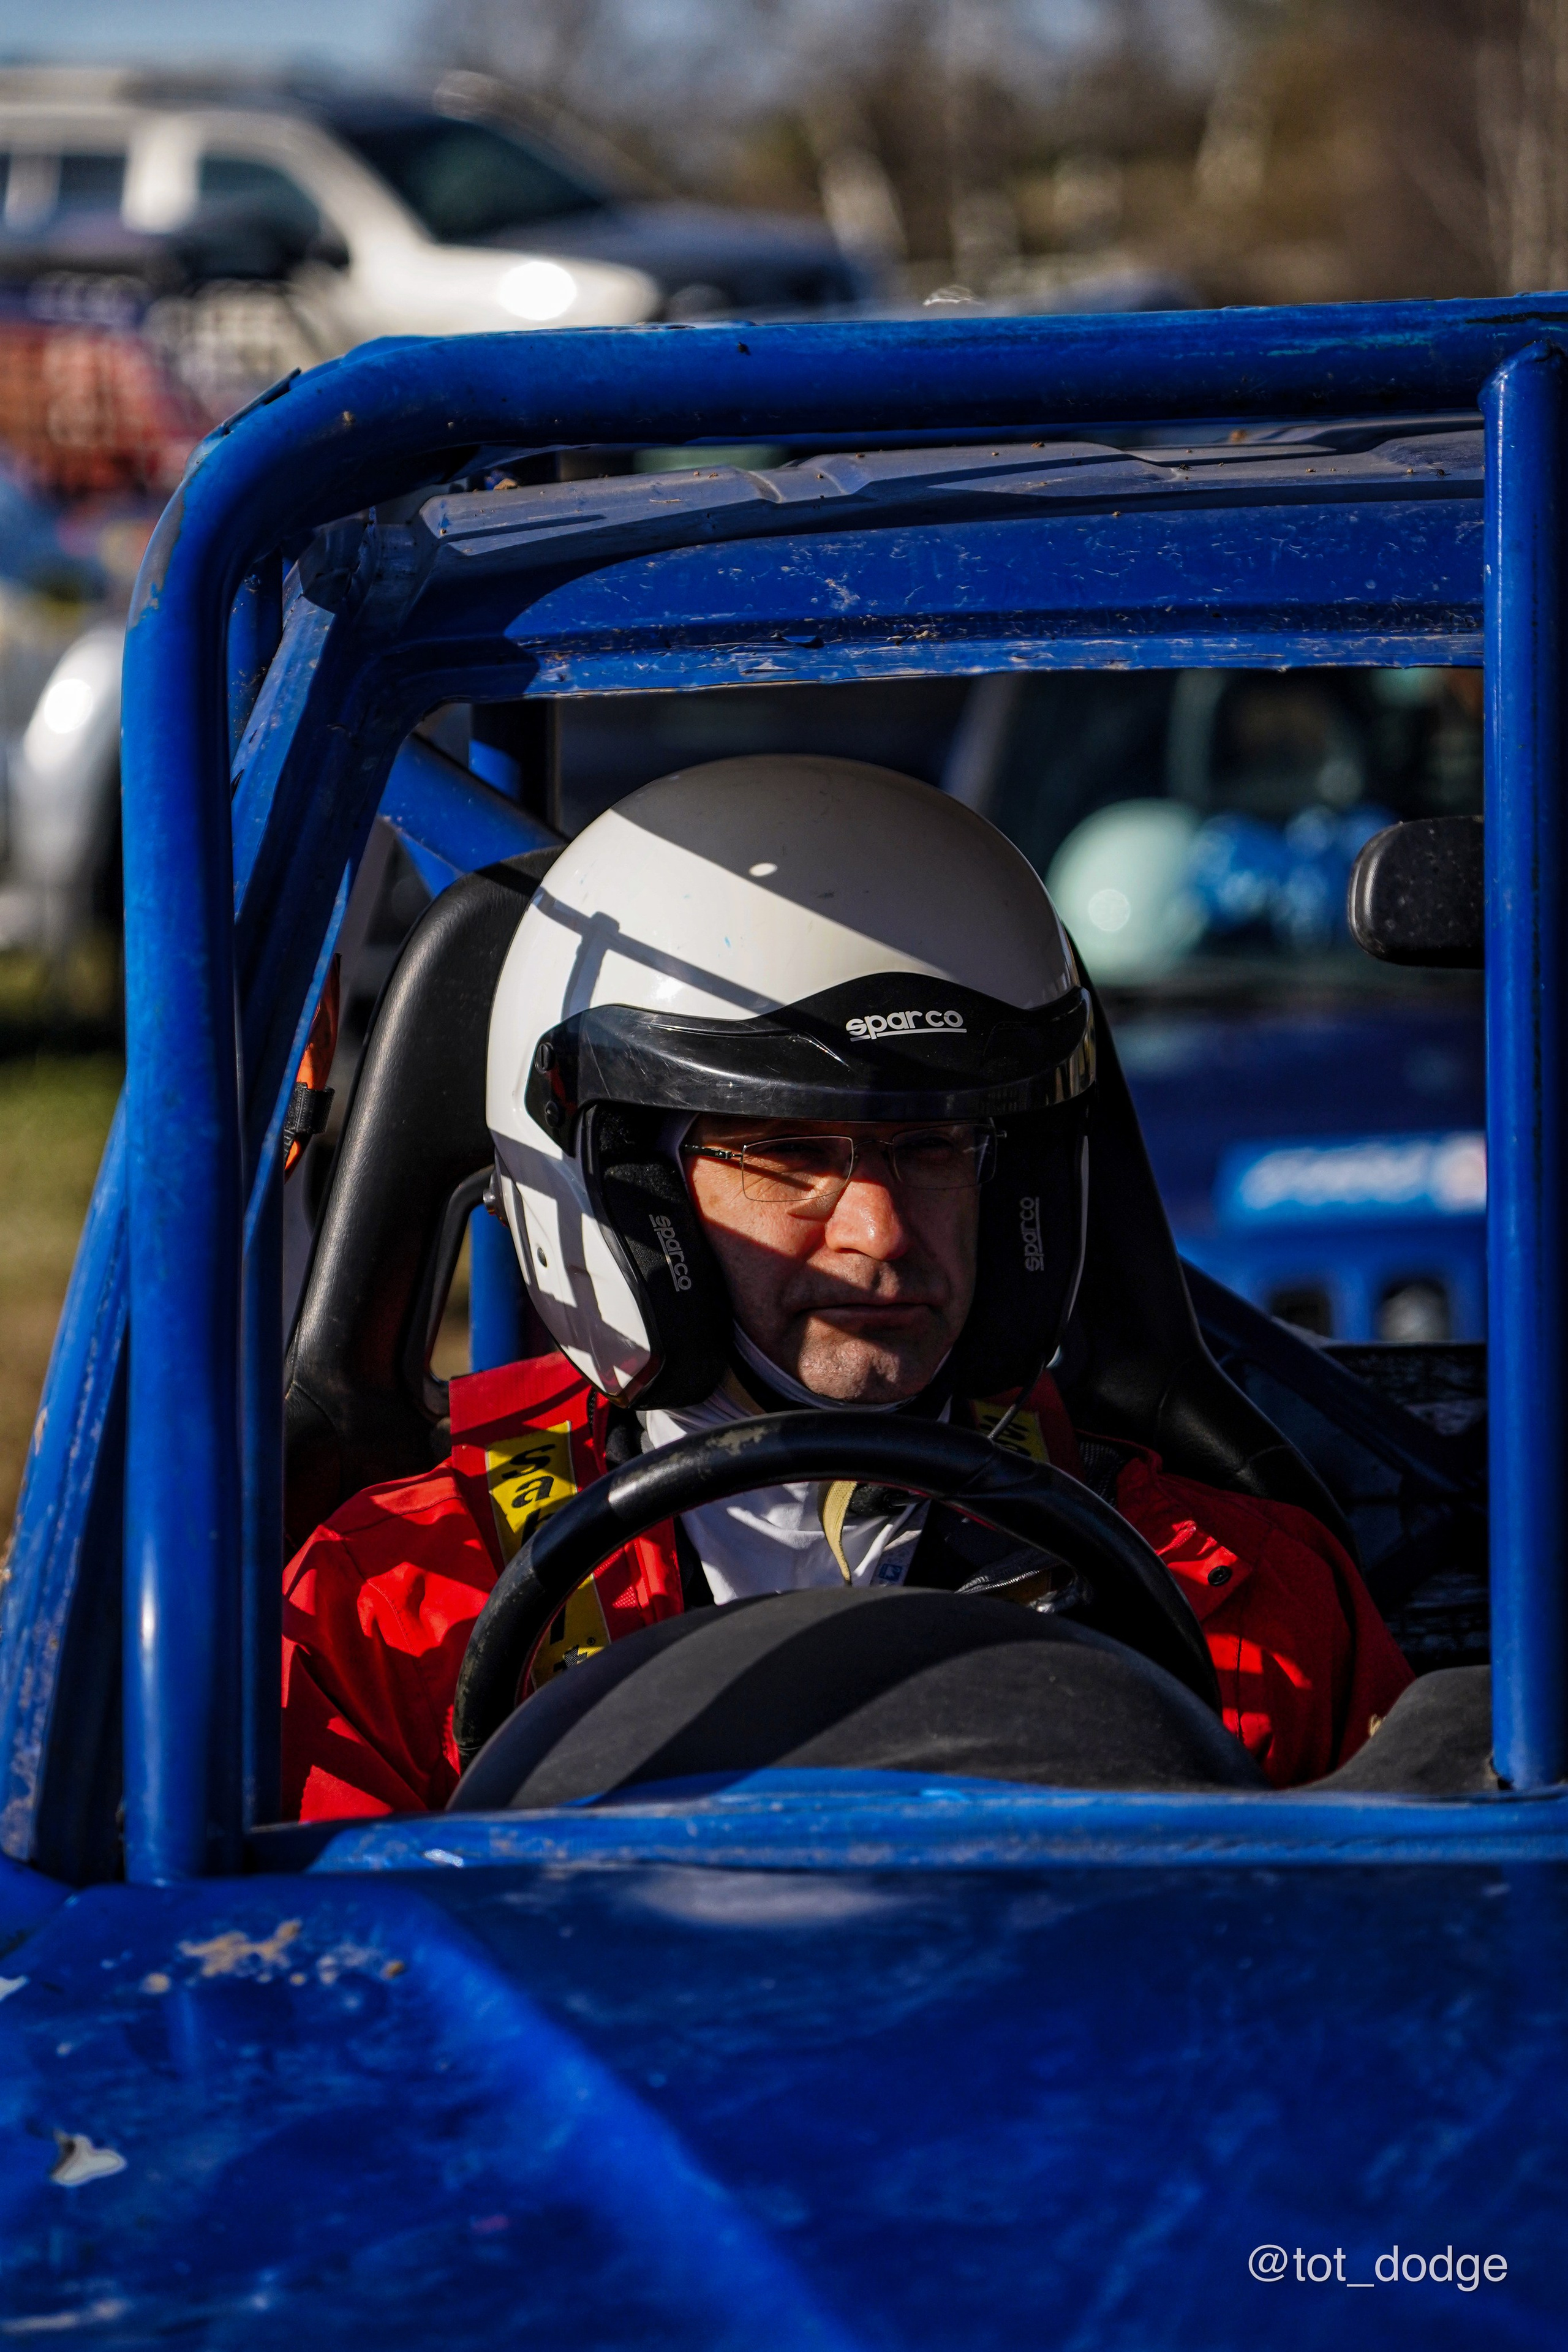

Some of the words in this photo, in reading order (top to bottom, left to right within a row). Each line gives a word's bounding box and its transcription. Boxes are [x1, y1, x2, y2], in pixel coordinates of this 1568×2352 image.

[846, 1011, 967, 1041] sparco
[649, 1215, 692, 1291] sparco
[1019, 1197, 1044, 1271] sparco
